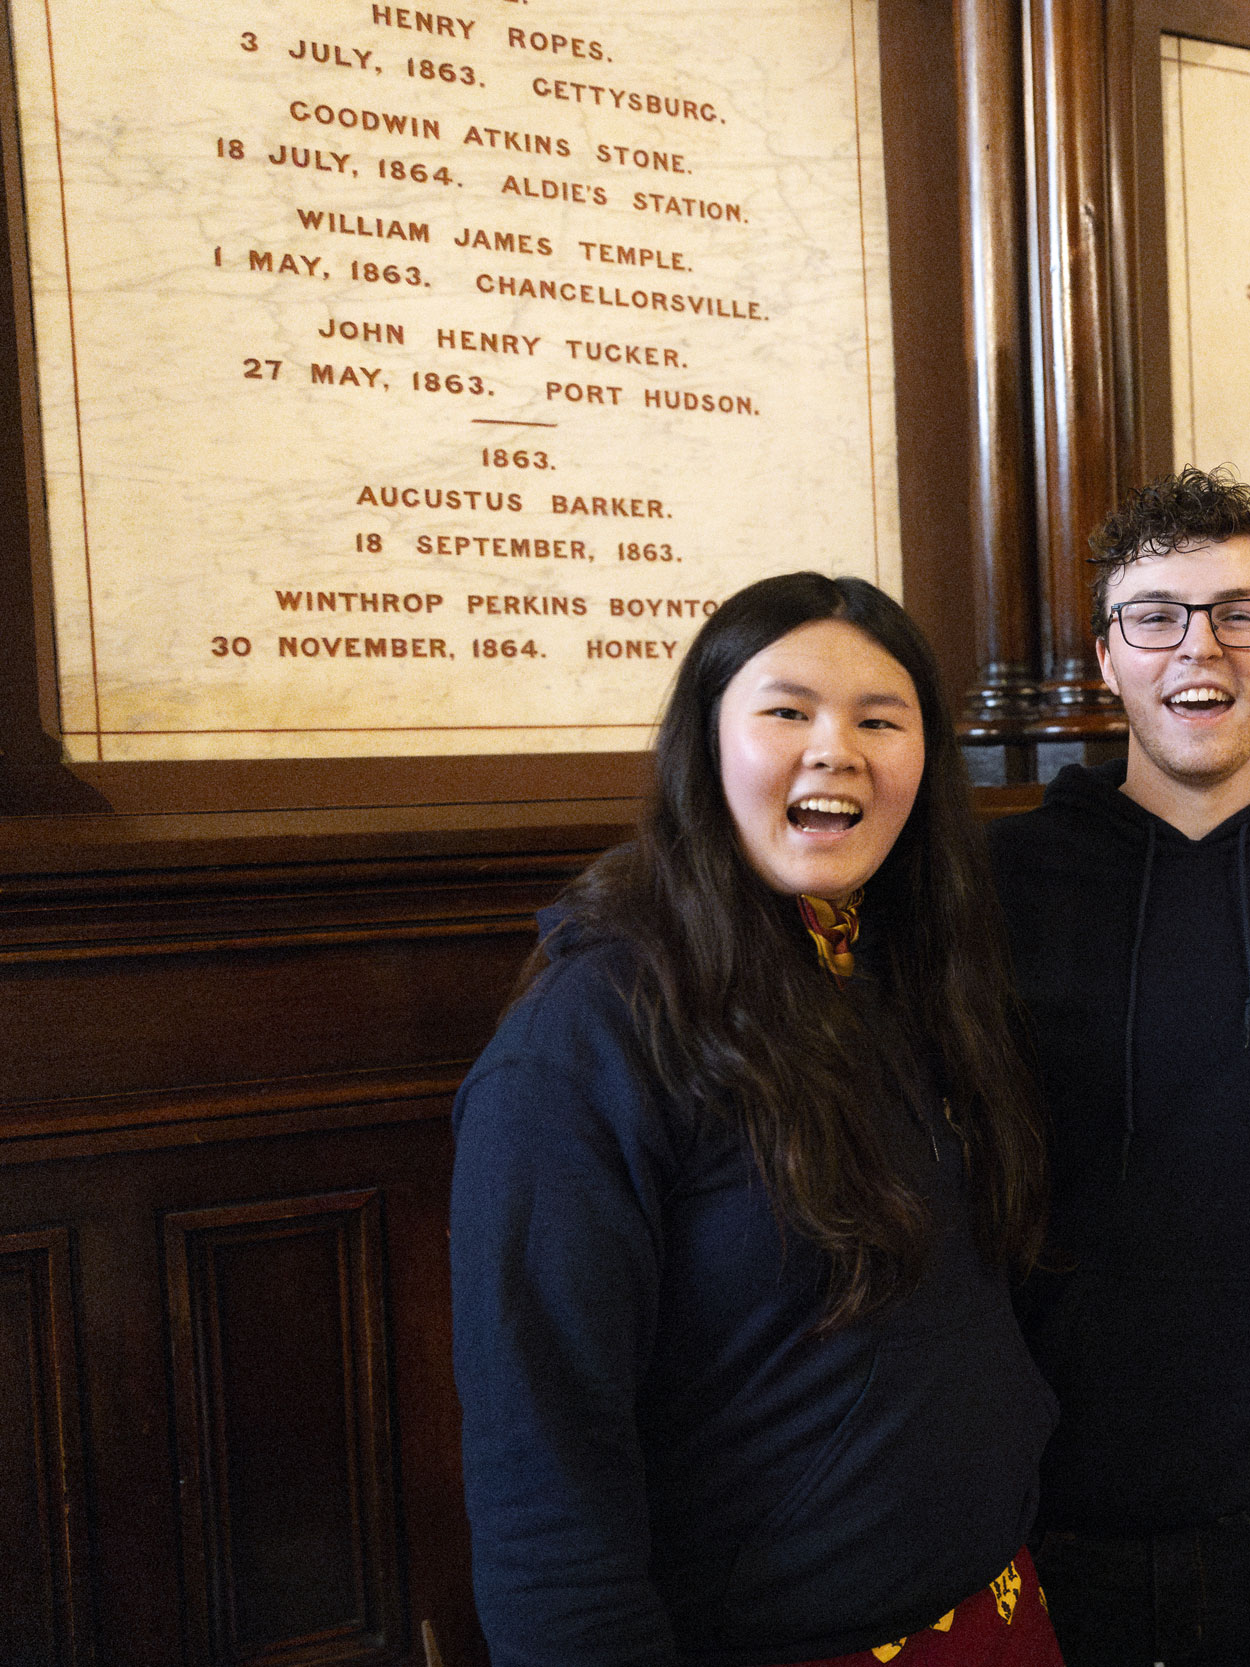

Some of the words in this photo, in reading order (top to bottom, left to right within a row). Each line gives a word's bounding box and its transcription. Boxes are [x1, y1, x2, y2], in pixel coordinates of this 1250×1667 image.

[372, 3, 475, 40] HENRY
[508, 27, 612, 63] ROPES.
[240, 31, 259, 53] 3
[288, 40, 382, 75] JULY,
[407, 58, 485, 88] 1863.
[532, 77, 726, 124] GETTYSBURG.
[289, 100, 440, 140] GOODWIN
[463, 126, 571, 157] ATKINS
[596, 144, 692, 174] STONE.
[217, 137, 245, 161] 18
[268, 145, 358, 178] JULY,
[378, 159, 463, 188] 1864.
[501, 175, 608, 206] ALDIE'S
[633, 192, 748, 223] STATION.
[296, 208, 430, 243] WILLIAM
[454, 228, 553, 256] JAMES
[578, 241, 692, 272] TEMPLE.
[214, 246, 222, 267] 1
[248, 249, 330, 281] MAY,
[351, 260, 431, 288] 1863.
[476, 273, 769, 321] CHANCELLORSVILLE.
[318, 318, 404, 345] JOHN
[437, 328, 541, 356] HENRY
[565, 340, 687, 368] TUCKER.
[243, 358, 283, 381] 27
[310, 363, 389, 391] MAY,
[412, 371, 494, 396] 1863.
[546, 381, 622, 405] PORT
[644, 389, 760, 416] HUDSON.
[482, 448, 556, 470] 1863.
[356, 485, 523, 512] AUGUSTUS
[551, 495, 672, 519] BARKER.
[356, 533, 383, 554] 18
[416, 535, 594, 562] SEPTEMBER,
[618, 542, 682, 562] 1863.
[275, 590, 444, 614] WINTHROP
[467, 595, 588, 616] PERKINS
[609, 598, 718, 618] BOYNTO
[211, 636, 252, 658] 30
[278, 636, 455, 660] NOVEMBER,
[472, 638, 546, 659] 1864.
[586, 639, 677, 659] HONEY
